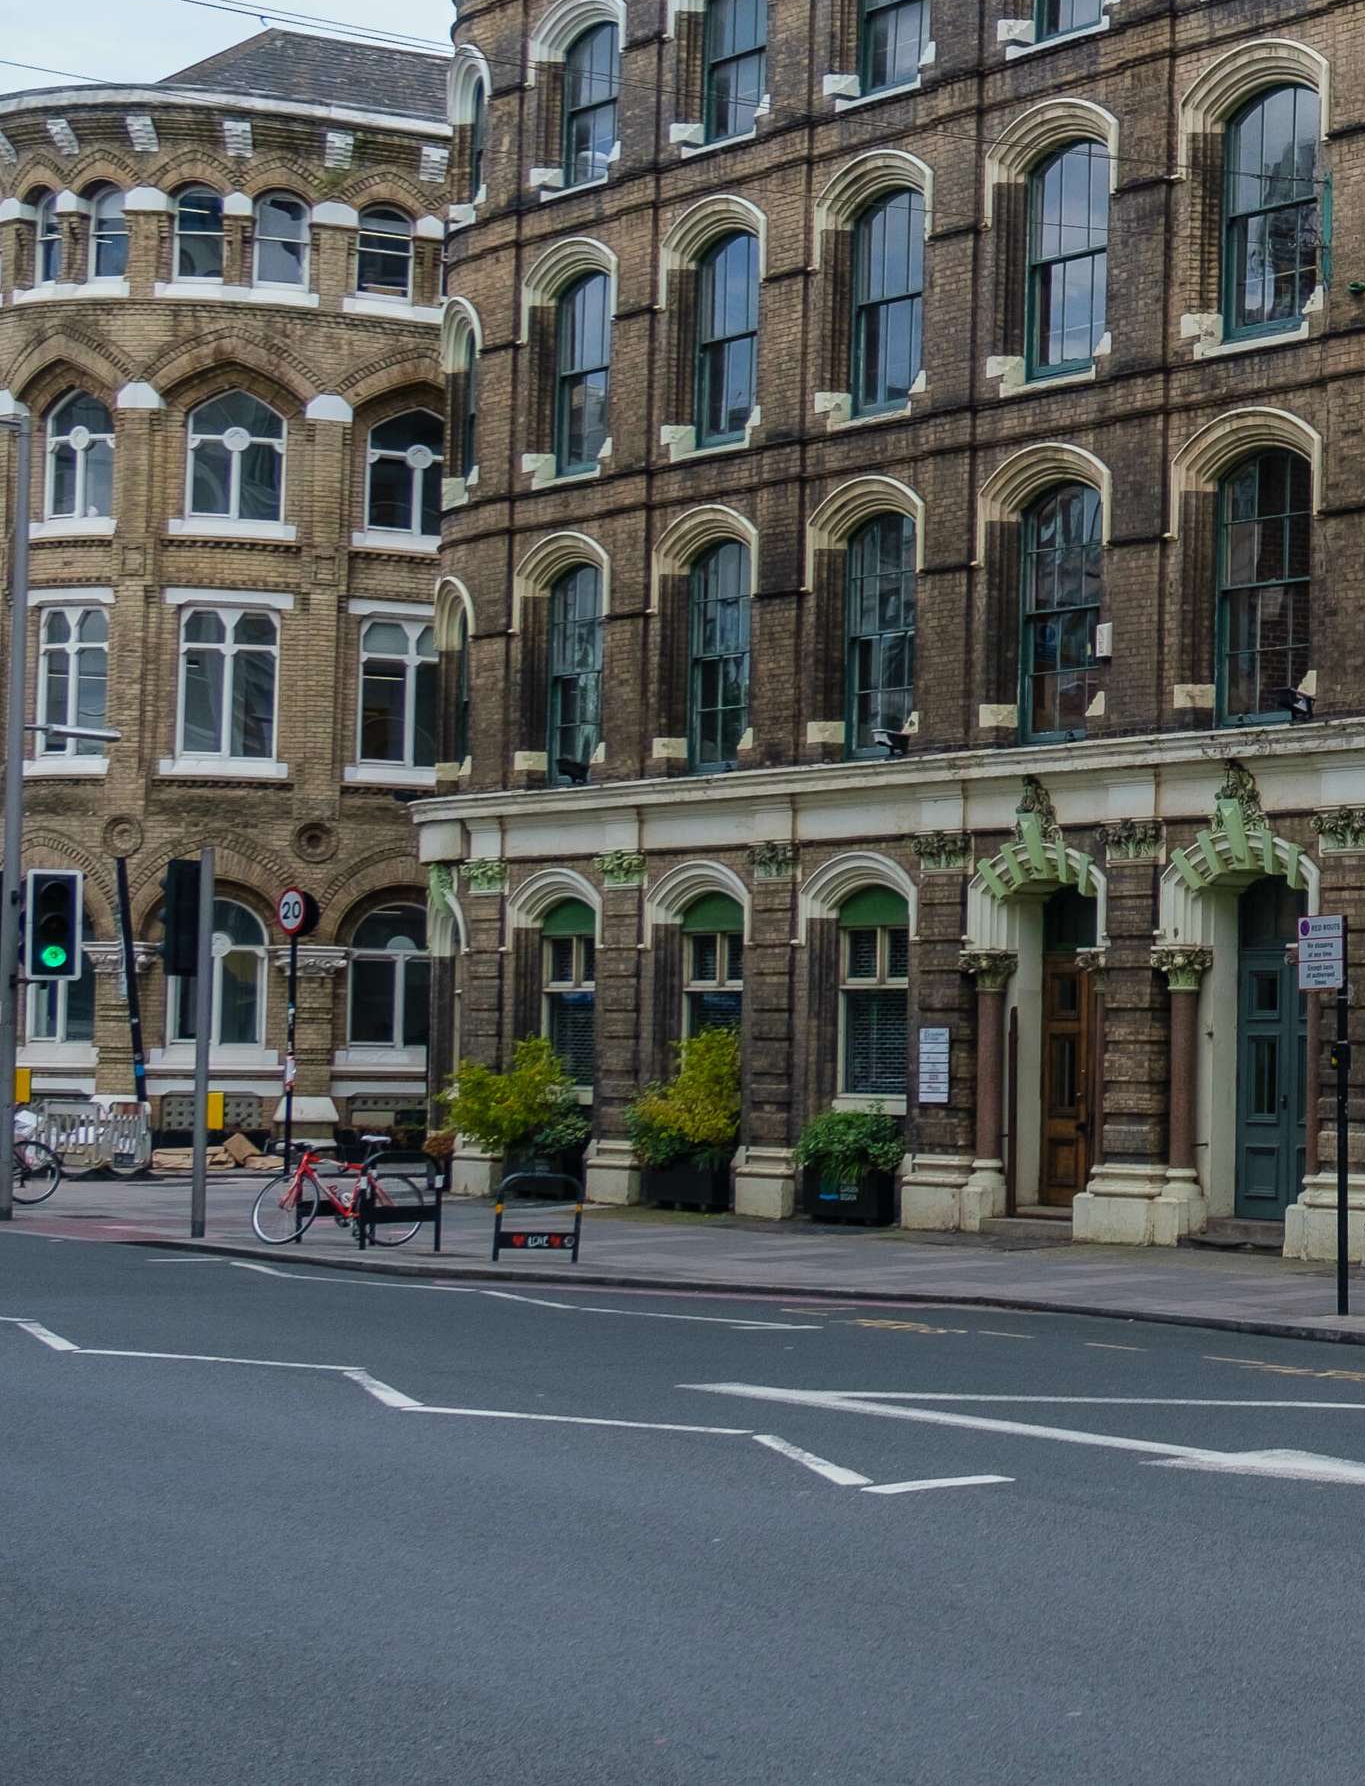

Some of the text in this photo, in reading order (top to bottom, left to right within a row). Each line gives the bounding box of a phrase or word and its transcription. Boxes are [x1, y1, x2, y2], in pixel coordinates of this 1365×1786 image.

[282, 900, 301, 920] 20
[1311, 923, 1340, 932] RED ROUTE
